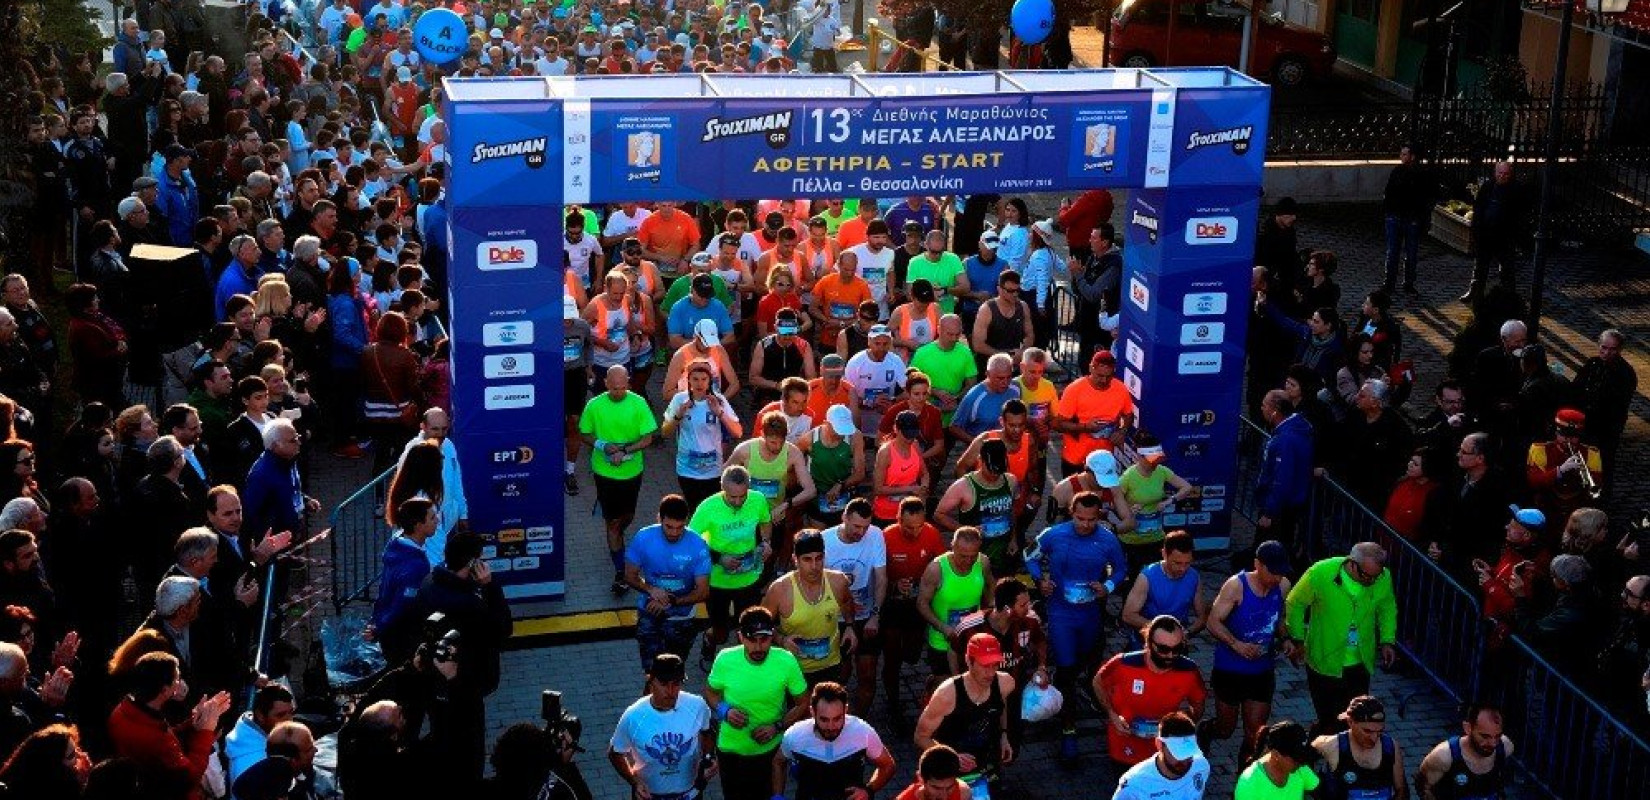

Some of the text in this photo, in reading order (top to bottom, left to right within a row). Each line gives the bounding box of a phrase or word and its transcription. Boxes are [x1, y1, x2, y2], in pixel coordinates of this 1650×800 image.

[421, 36, 462, 53] BLOCK
[873, 107, 938, 123] Διεθνής
[946, 105, 1049, 123] Μαραθώνιος
[702, 111, 791, 142] STOIXIMAN
[860, 124, 1056, 145] ΜΕΓΑΣ ΑΛΕΞΑΝΔΡΟΣ
[769, 133, 786, 143] GR
[472, 138, 546, 163] STOIXIMAN
[528, 155, 542, 163] GR
[752, 156, 892, 173] ΑΦΕΤΗΡΙΑ
[921, 152, 1005, 170] START
[792, 177, 843, 193] Πέλλα
[860, 175, 964, 193] Θεσσαλονίκη
[1196, 222, 1227, 237] Dole
[489, 246, 525, 261] Dole
